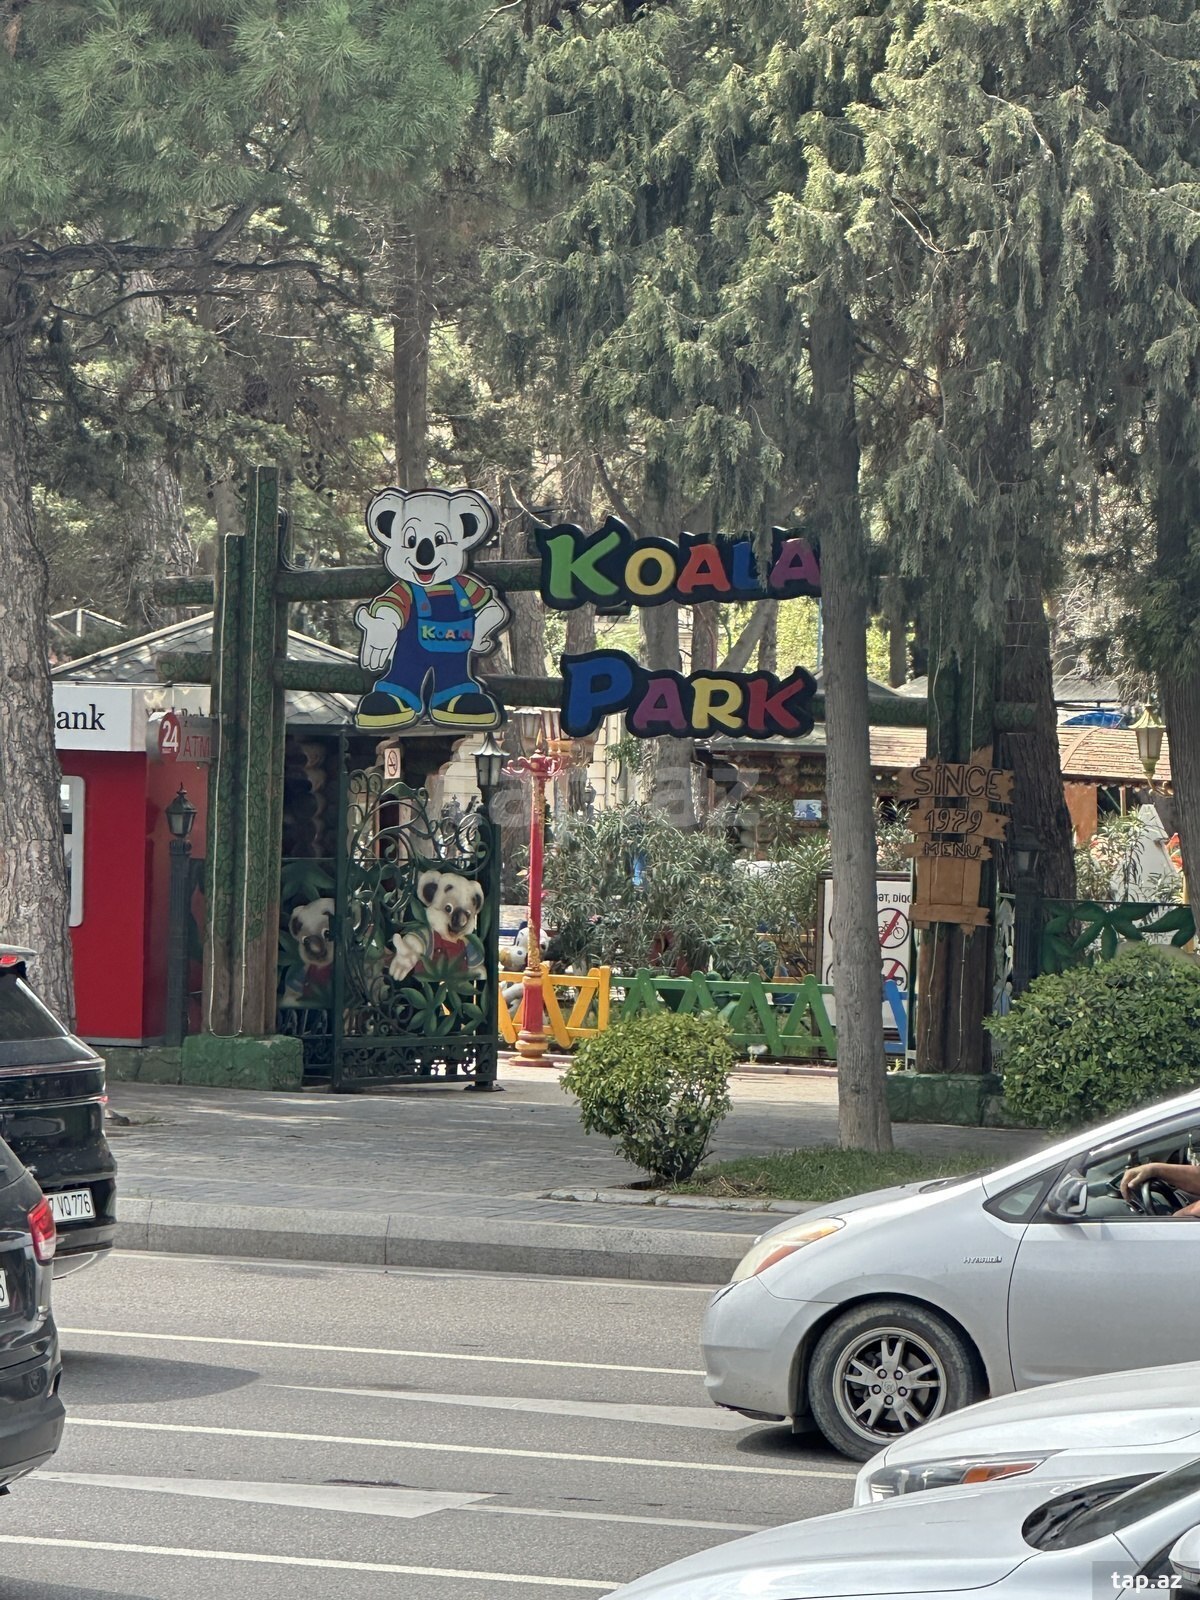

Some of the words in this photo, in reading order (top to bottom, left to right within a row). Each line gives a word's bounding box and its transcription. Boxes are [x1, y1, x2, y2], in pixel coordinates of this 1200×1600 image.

[545, 531, 821, 600] KOALA
[566, 656, 807, 731] PARK
[56, 703, 106, 731] ank
[162, 720, 179, 753] 24
[184, 735, 210, 758] ATM
[924, 842, 981, 859] MENU
